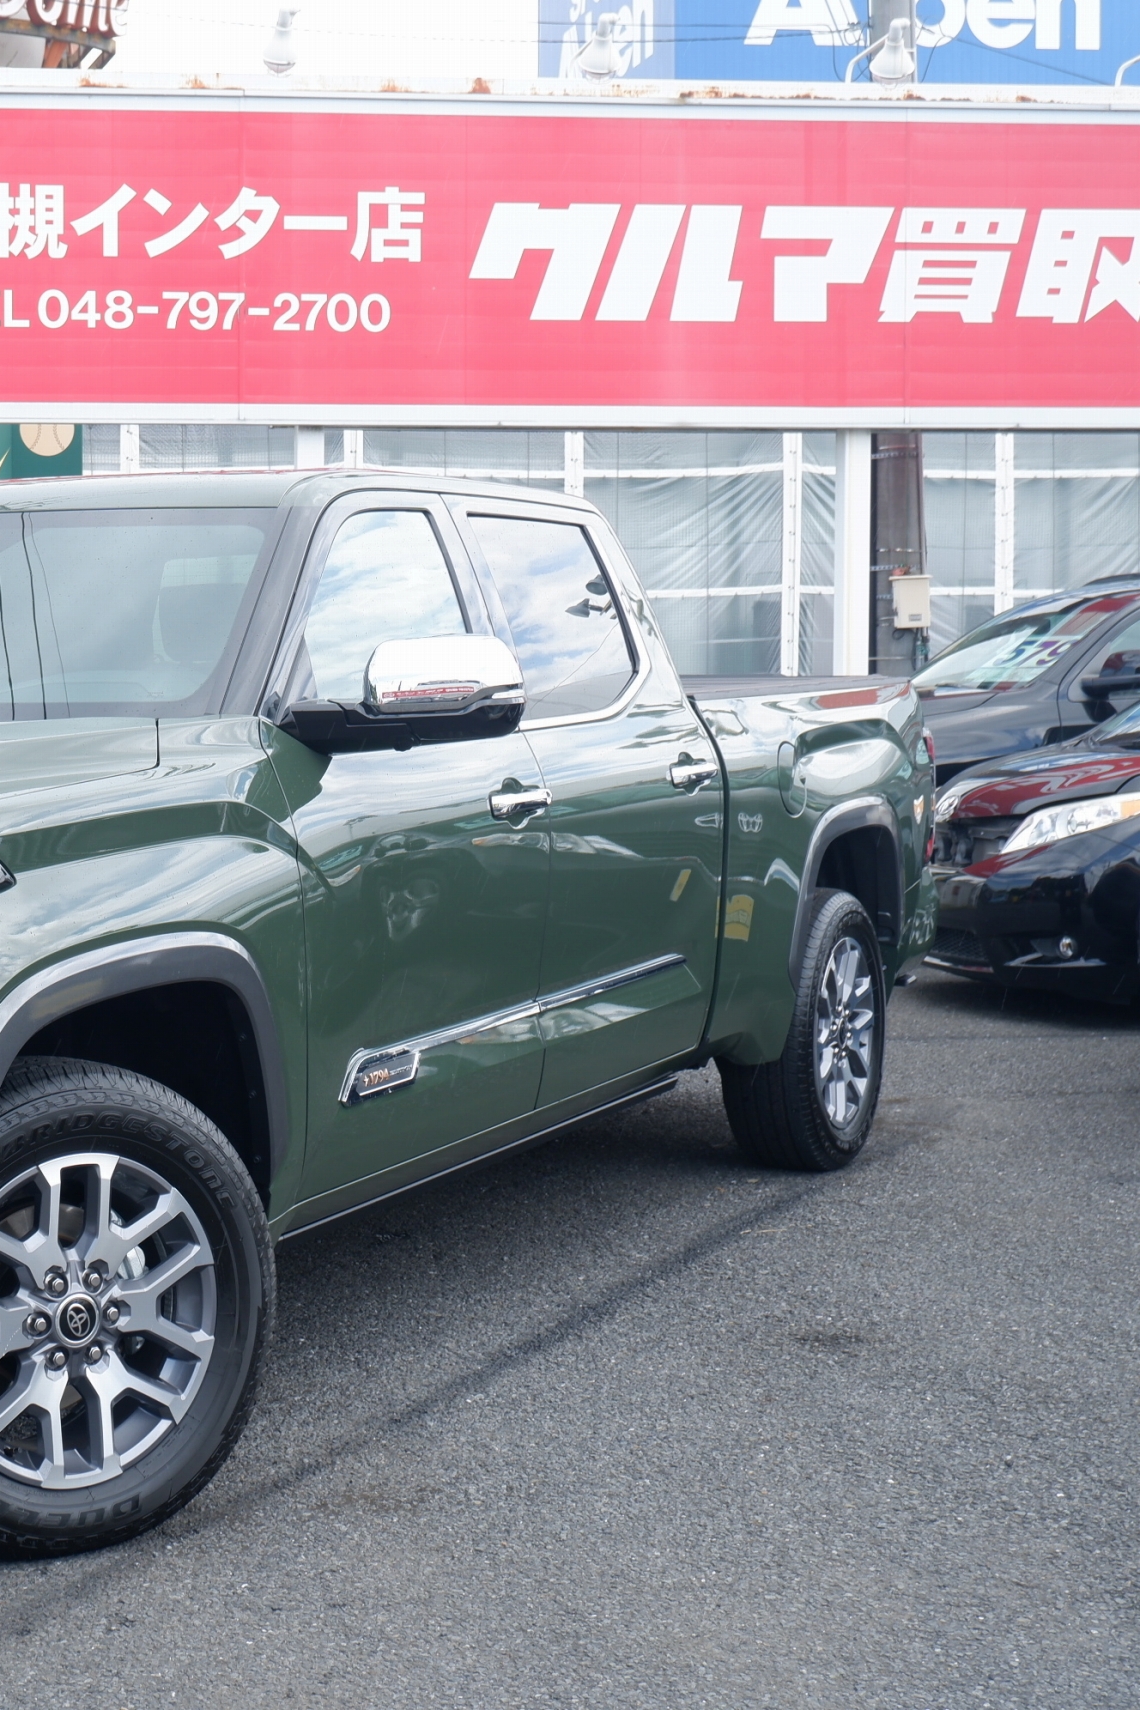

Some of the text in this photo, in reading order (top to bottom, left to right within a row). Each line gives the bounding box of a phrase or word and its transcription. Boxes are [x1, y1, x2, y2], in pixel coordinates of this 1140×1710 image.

[743, 0, 1101, 50] Aen
[468, 202, 1140, 323] クルマ買取
[38, 289, 391, 333] 048-797-2700
